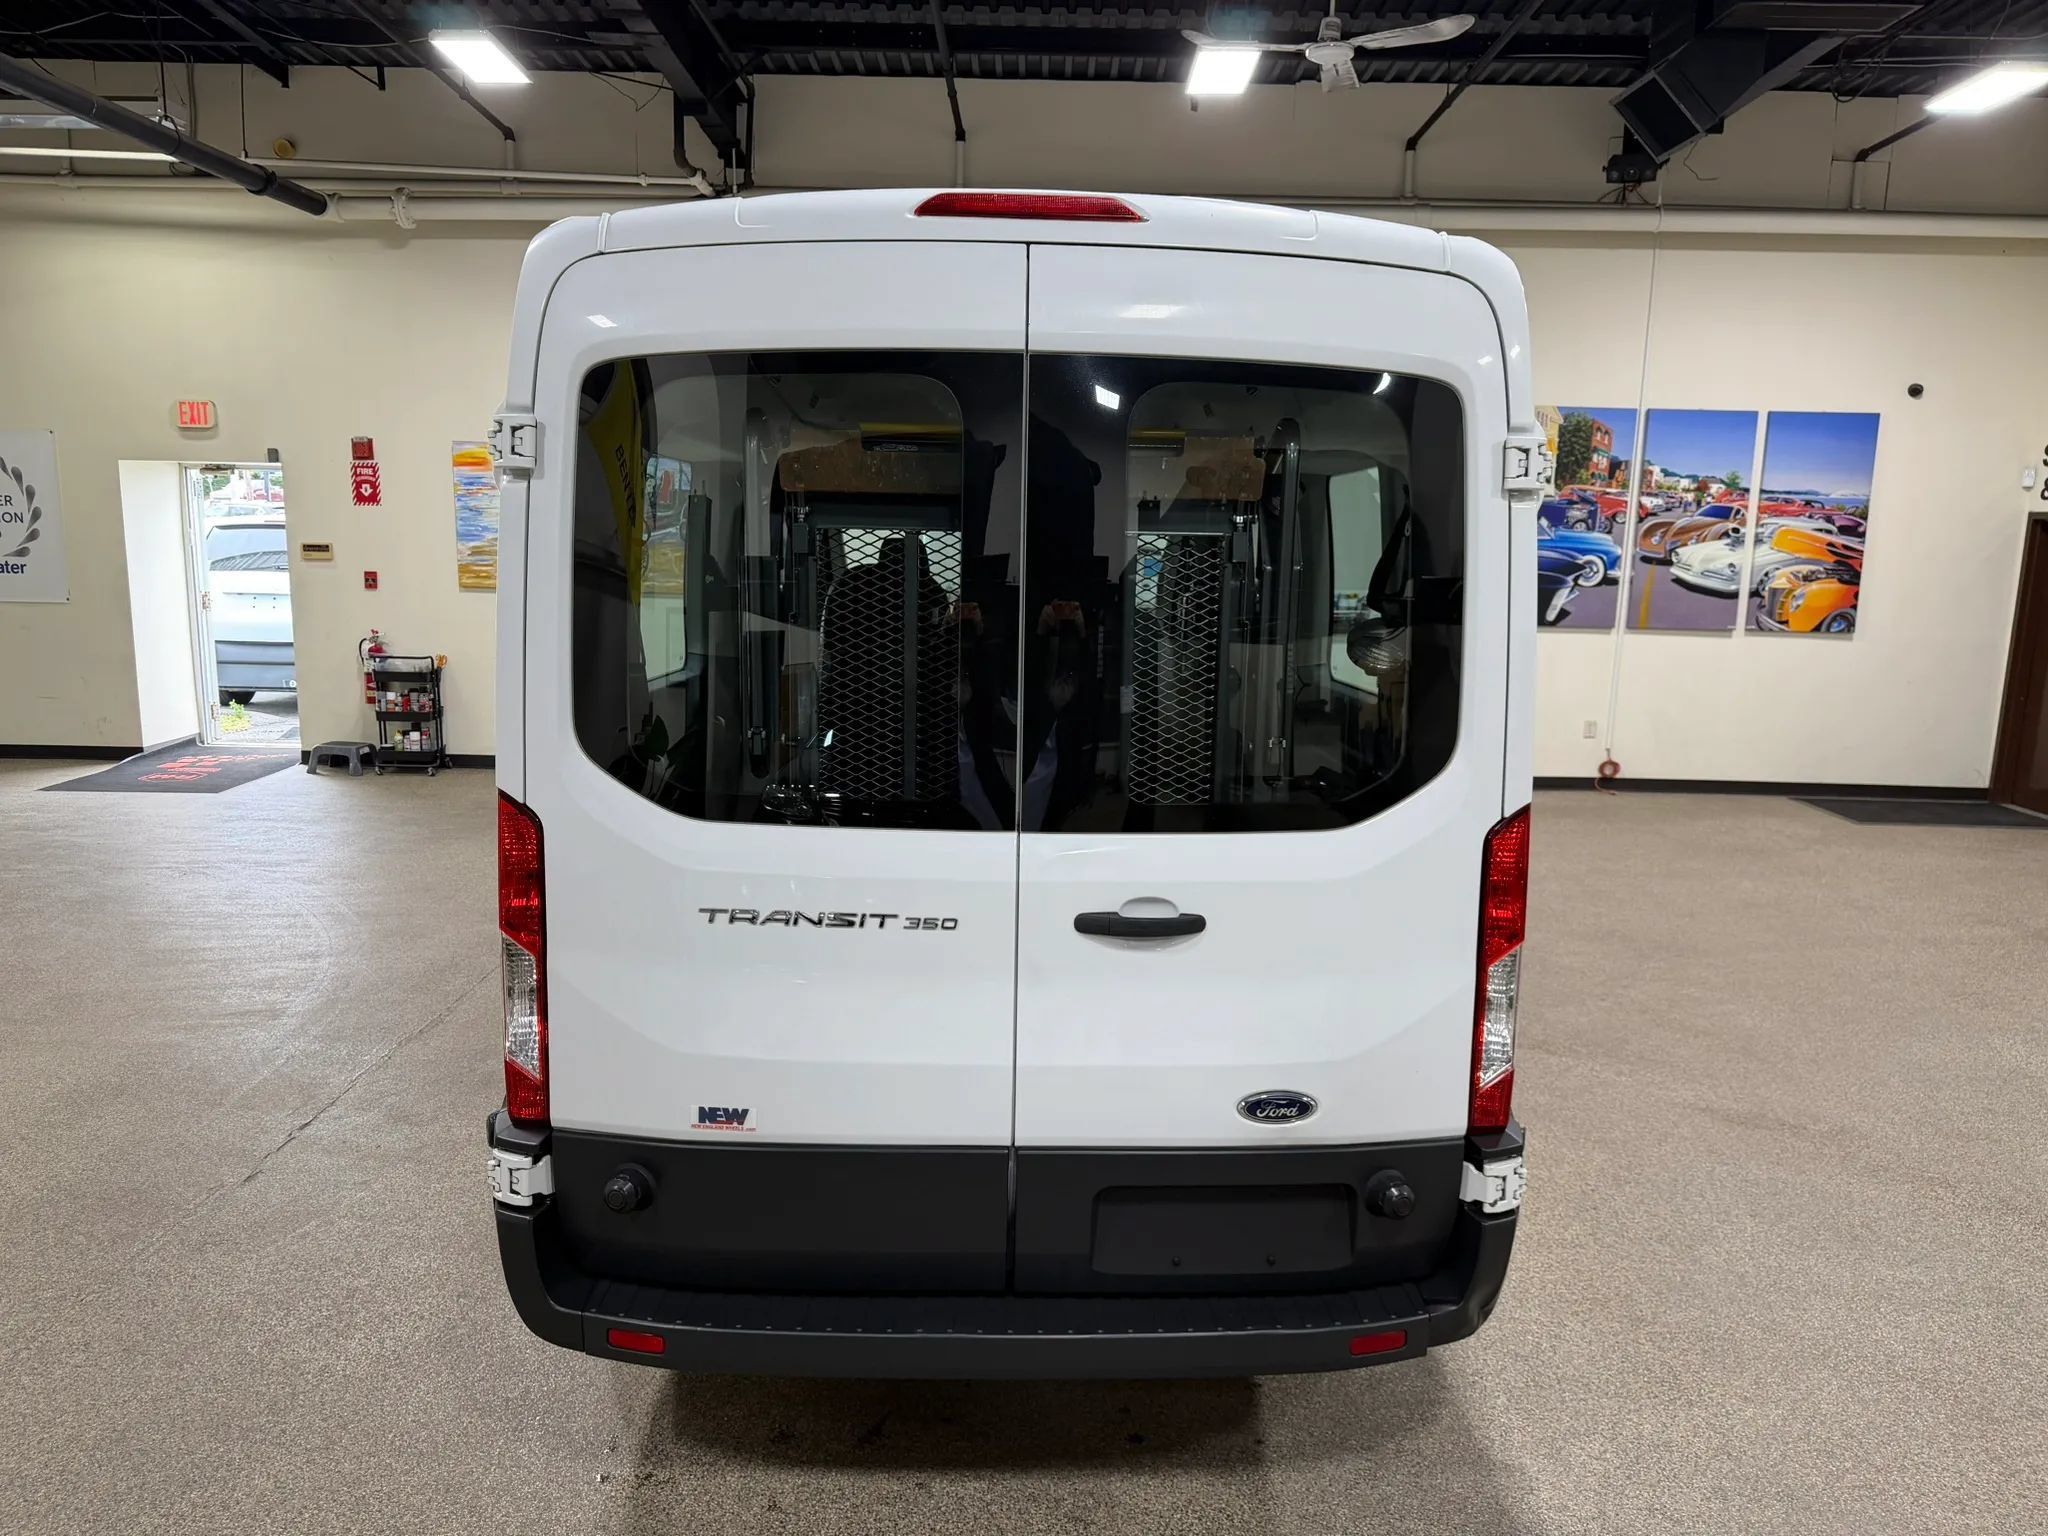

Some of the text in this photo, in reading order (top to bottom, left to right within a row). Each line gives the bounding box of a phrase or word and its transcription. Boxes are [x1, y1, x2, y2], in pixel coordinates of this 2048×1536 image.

[179, 401, 209, 426] EXIT
[356, 467, 374, 475] FIRE
[698, 908, 958, 931] TRANSIT 350
[698, 1106, 750, 1126] NEW
[1256, 1100, 1300, 1117] Ford
